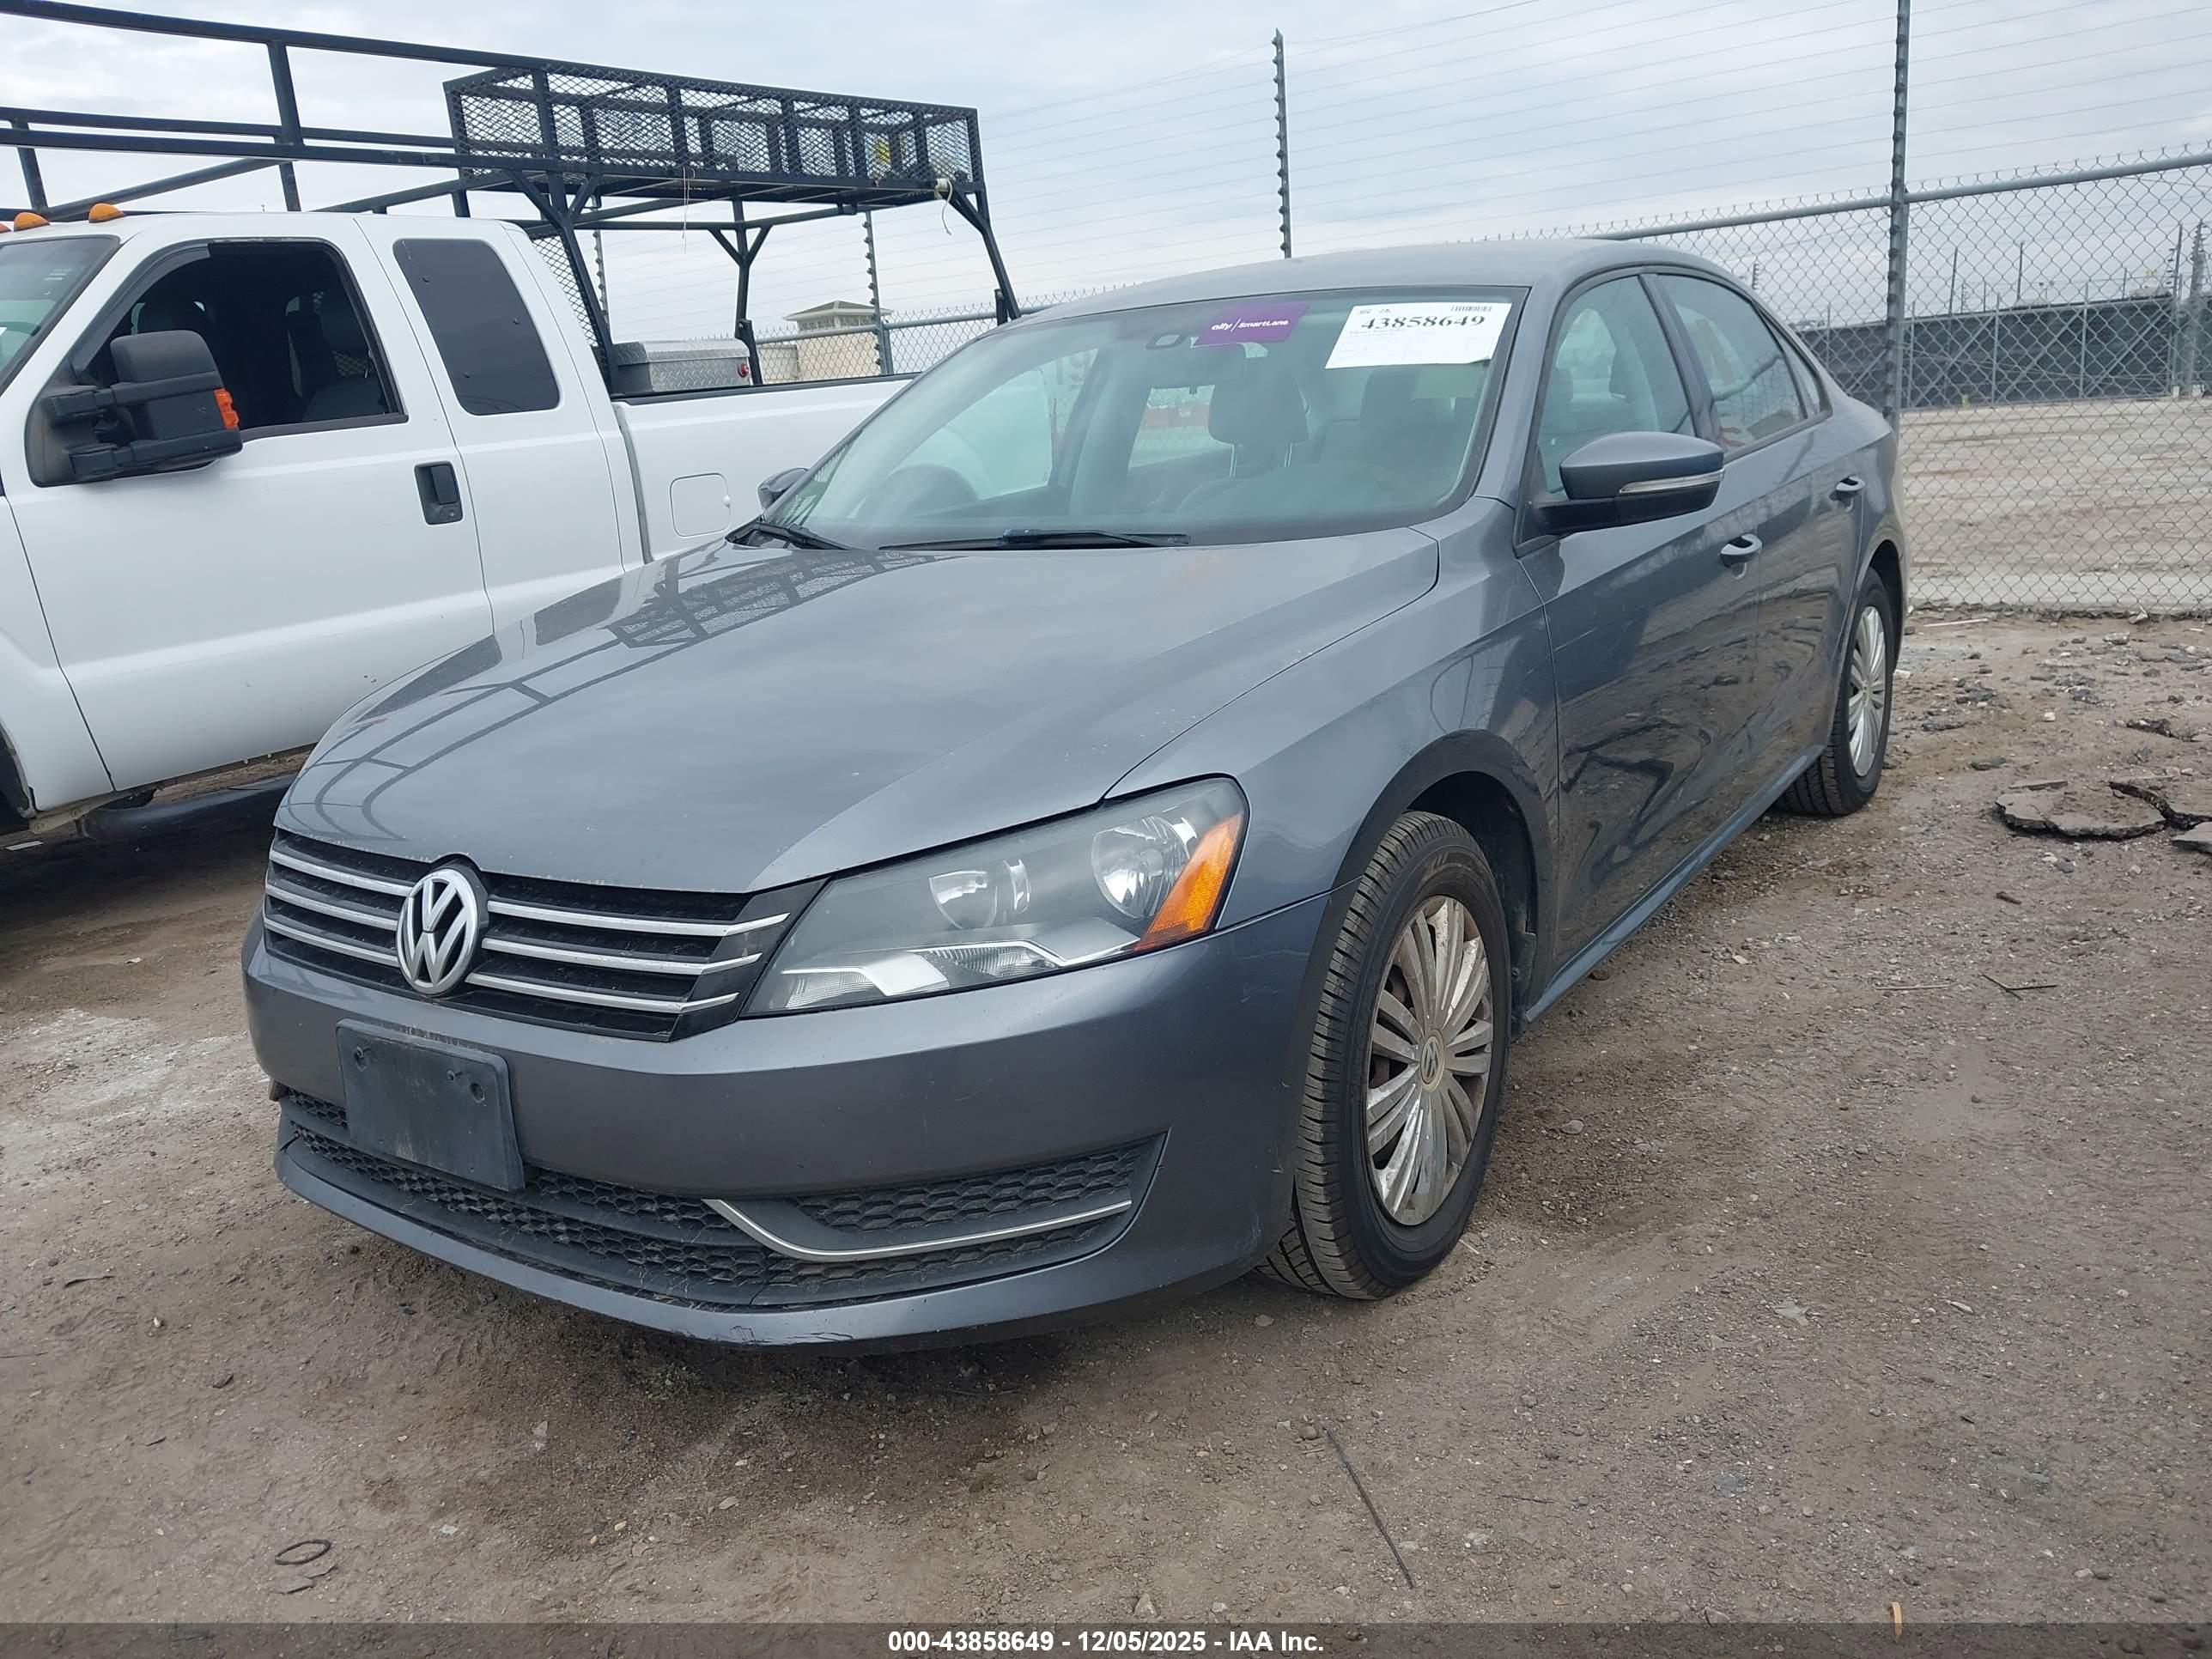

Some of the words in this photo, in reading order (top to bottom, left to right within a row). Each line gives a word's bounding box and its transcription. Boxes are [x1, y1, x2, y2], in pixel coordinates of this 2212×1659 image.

[1211, 322, 1233, 331] ally
[1361, 315, 1486, 330] 43858649
[401, 874, 475, 990] VW
